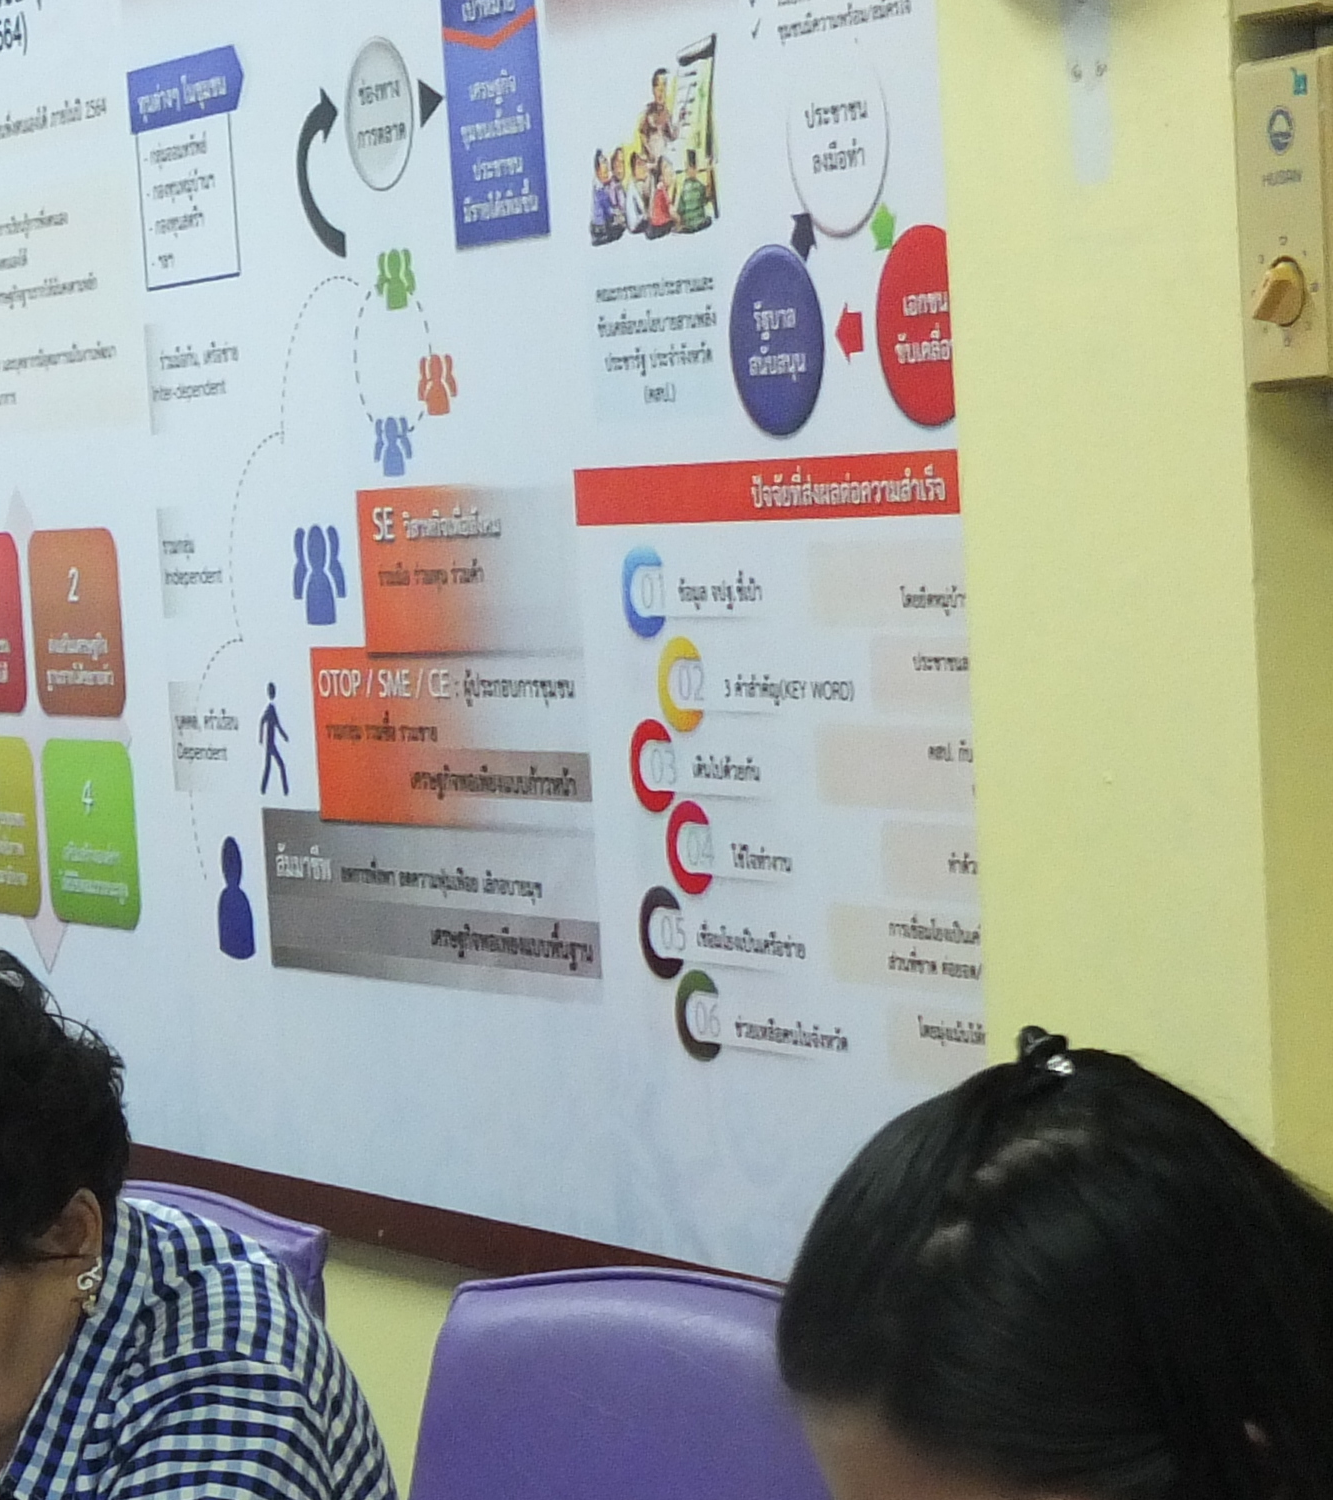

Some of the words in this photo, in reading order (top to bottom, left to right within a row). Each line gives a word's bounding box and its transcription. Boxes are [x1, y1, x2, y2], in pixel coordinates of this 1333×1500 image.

[894, 323, 953, 364] ขับเคลื่อ
[371, 506, 397, 542] SE
[66, 566, 80, 602] 2
[318, 669, 362, 698] OTOP
[378, 669, 412, 698] SME
[428, 669, 451, 698] CE
[81, 780, 94, 816] 4
